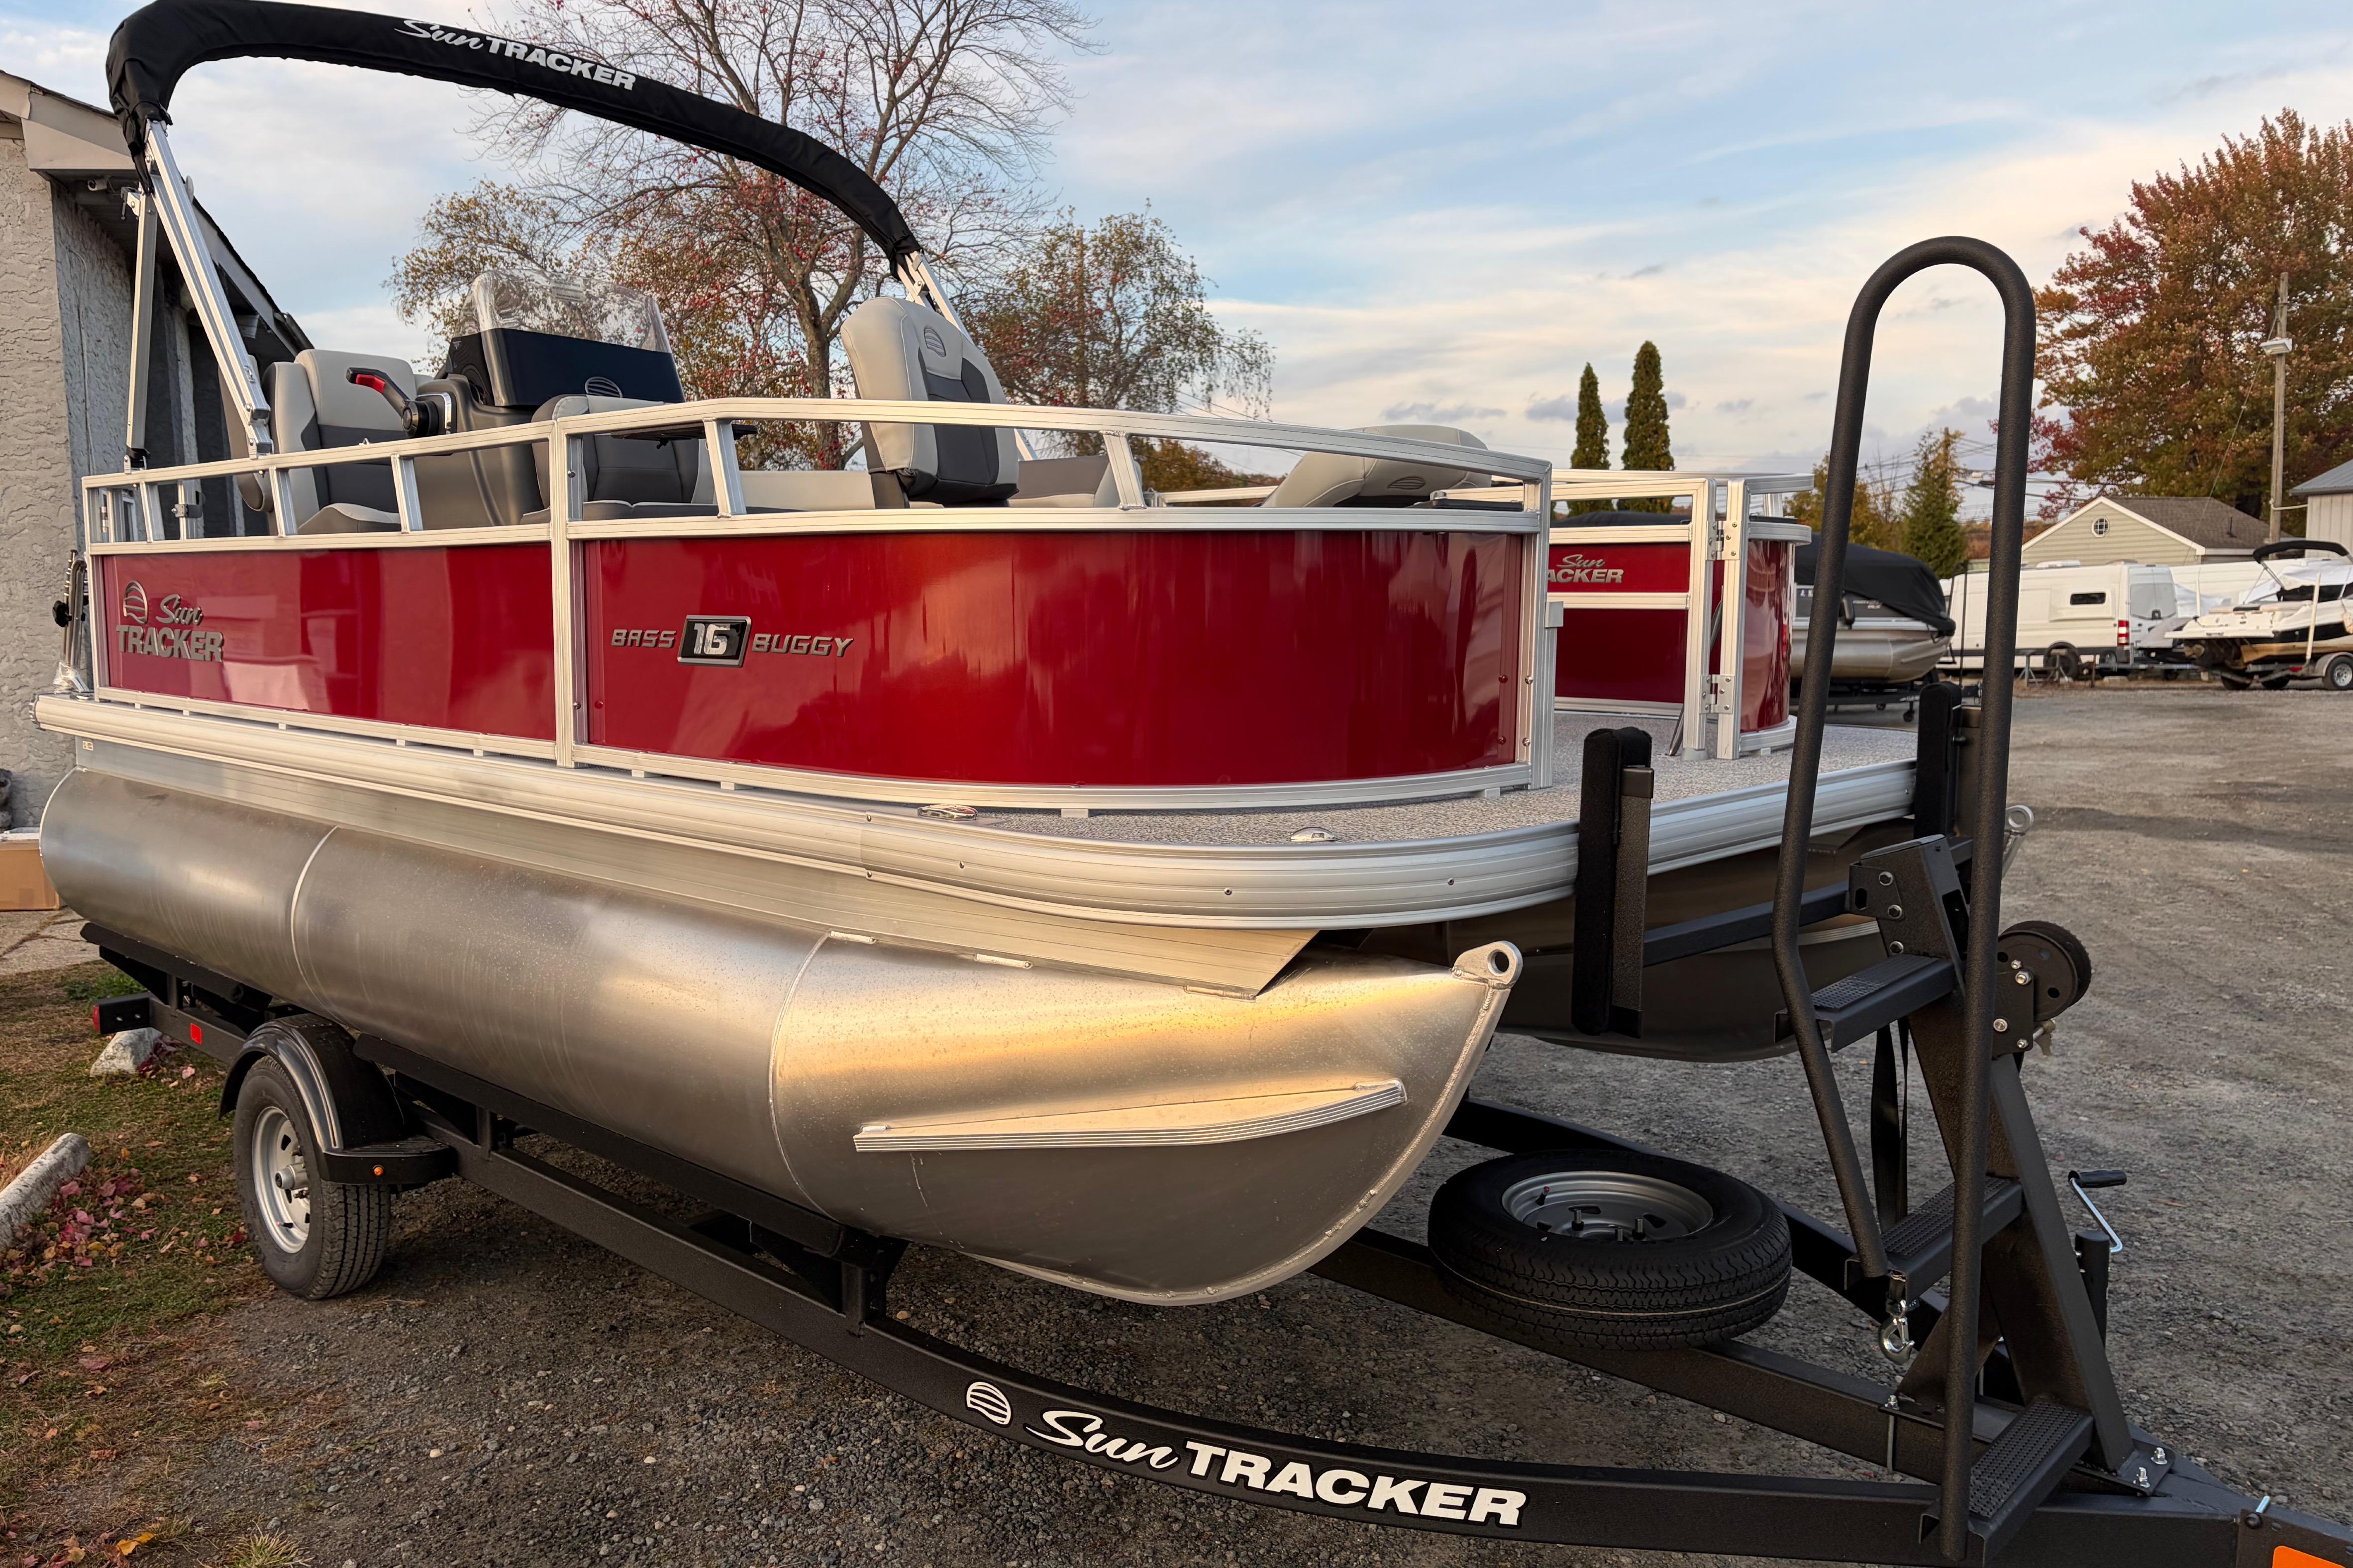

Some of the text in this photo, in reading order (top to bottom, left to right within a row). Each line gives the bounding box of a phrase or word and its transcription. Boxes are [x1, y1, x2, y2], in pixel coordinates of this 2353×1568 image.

[394, 19, 636, 91] Sun TRACKER
[1547, 569, 1624, 584] ACKER
[1556, 554, 1605, 569] Sun
[156, 593, 204, 626] Sun
[116, 624, 224, 663] TRACKER
[611, 622, 854, 658] BASS 16 BUGGY
[1024, 1409, 1528, 1527] Sun TRACKER
